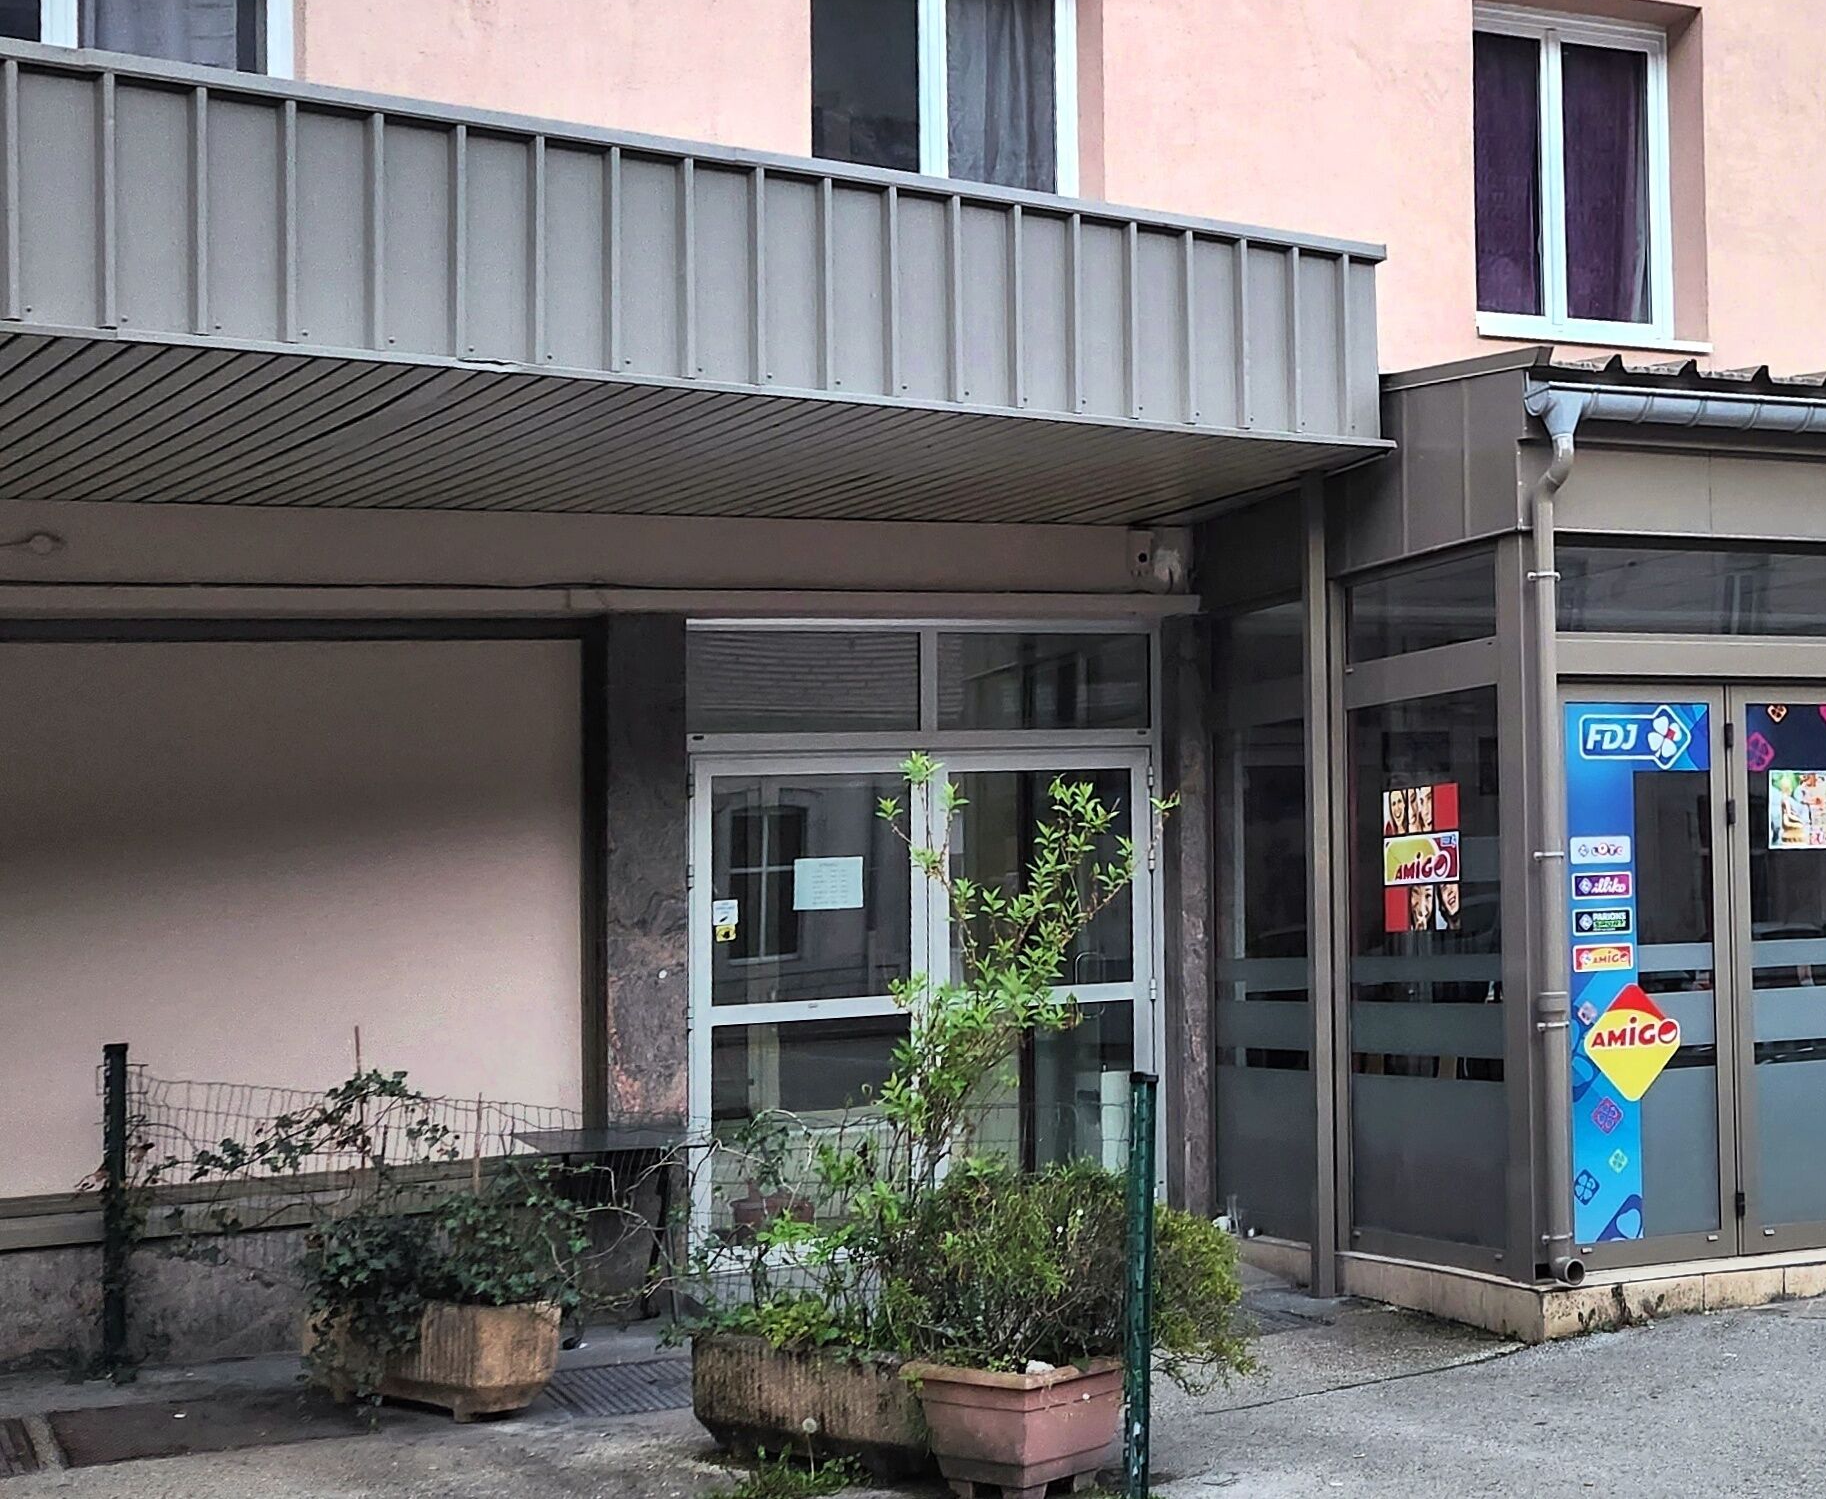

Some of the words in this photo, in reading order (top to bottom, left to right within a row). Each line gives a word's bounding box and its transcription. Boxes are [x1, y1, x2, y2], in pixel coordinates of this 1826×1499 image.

[1585, 723, 1638, 750] FDJ
[1395, 852, 1448, 881] AMIGO
[1591, 876, 1627, 893] illiko
[1593, 951, 1629, 964] AMIGO
[1591, 1016, 1678, 1048] AMIGO
